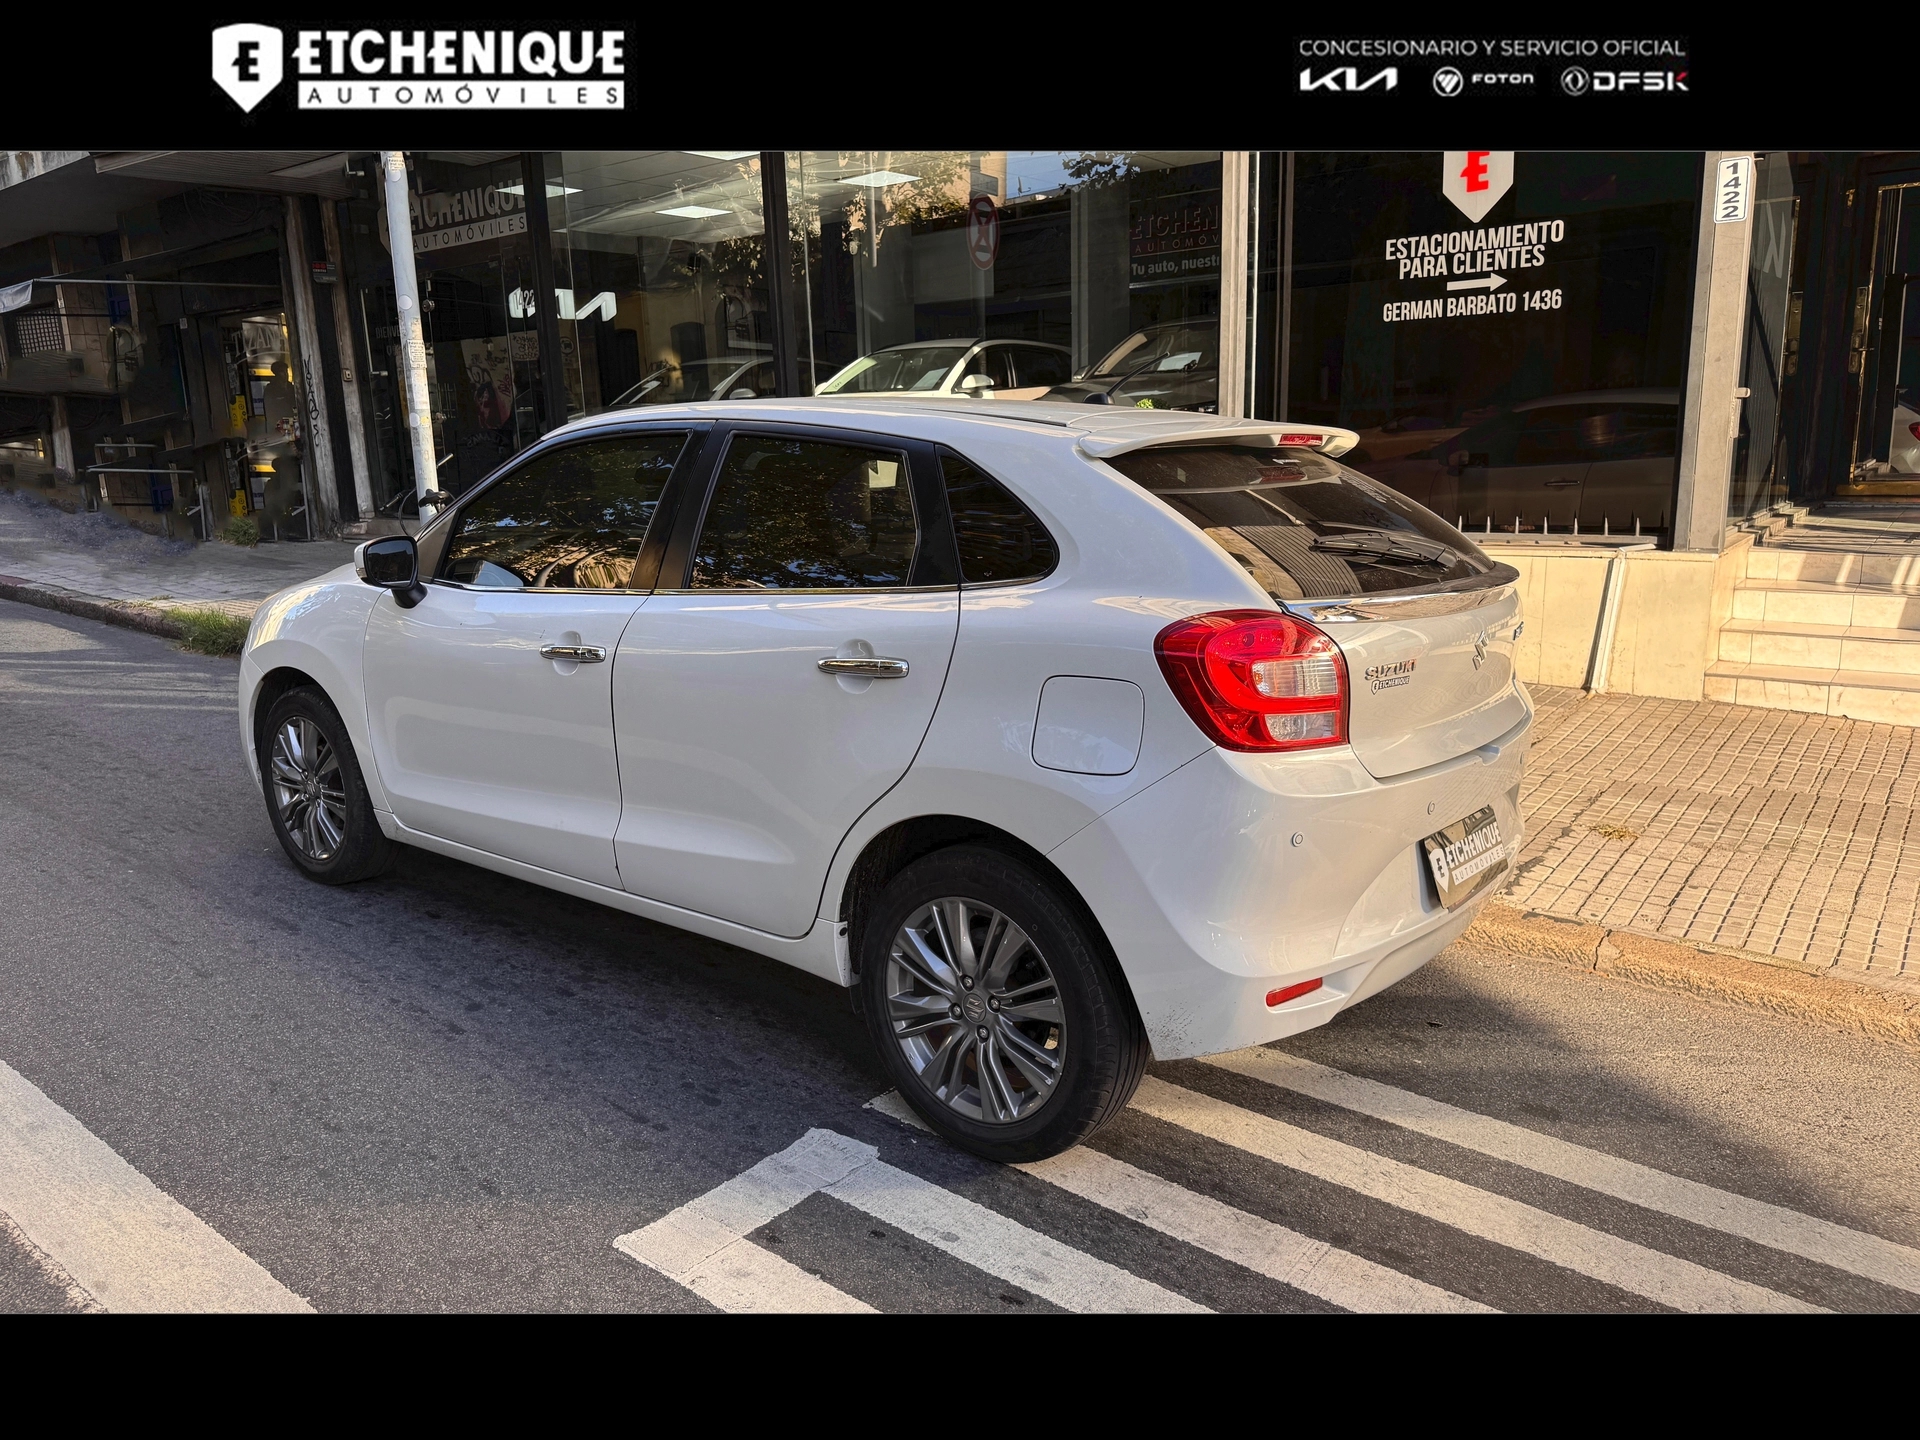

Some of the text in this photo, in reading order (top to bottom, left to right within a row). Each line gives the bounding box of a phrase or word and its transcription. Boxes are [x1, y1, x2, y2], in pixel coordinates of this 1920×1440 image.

[1721, 162, 1742, 219] 1422
[413, 216, 526, 250] AUTOMÓVILES
[1385, 219, 1565, 261] ESTACIONAMIENTO
[1131, 263, 1145, 276] Tu
[1147, 258, 1179, 275] auto,
[1399, 244, 1546, 280] PARA CLIENTES
[1383, 288, 1563, 322] GERMAN BARBATO 1436
[1445, 821, 1502, 869] ETCHENIQUE
